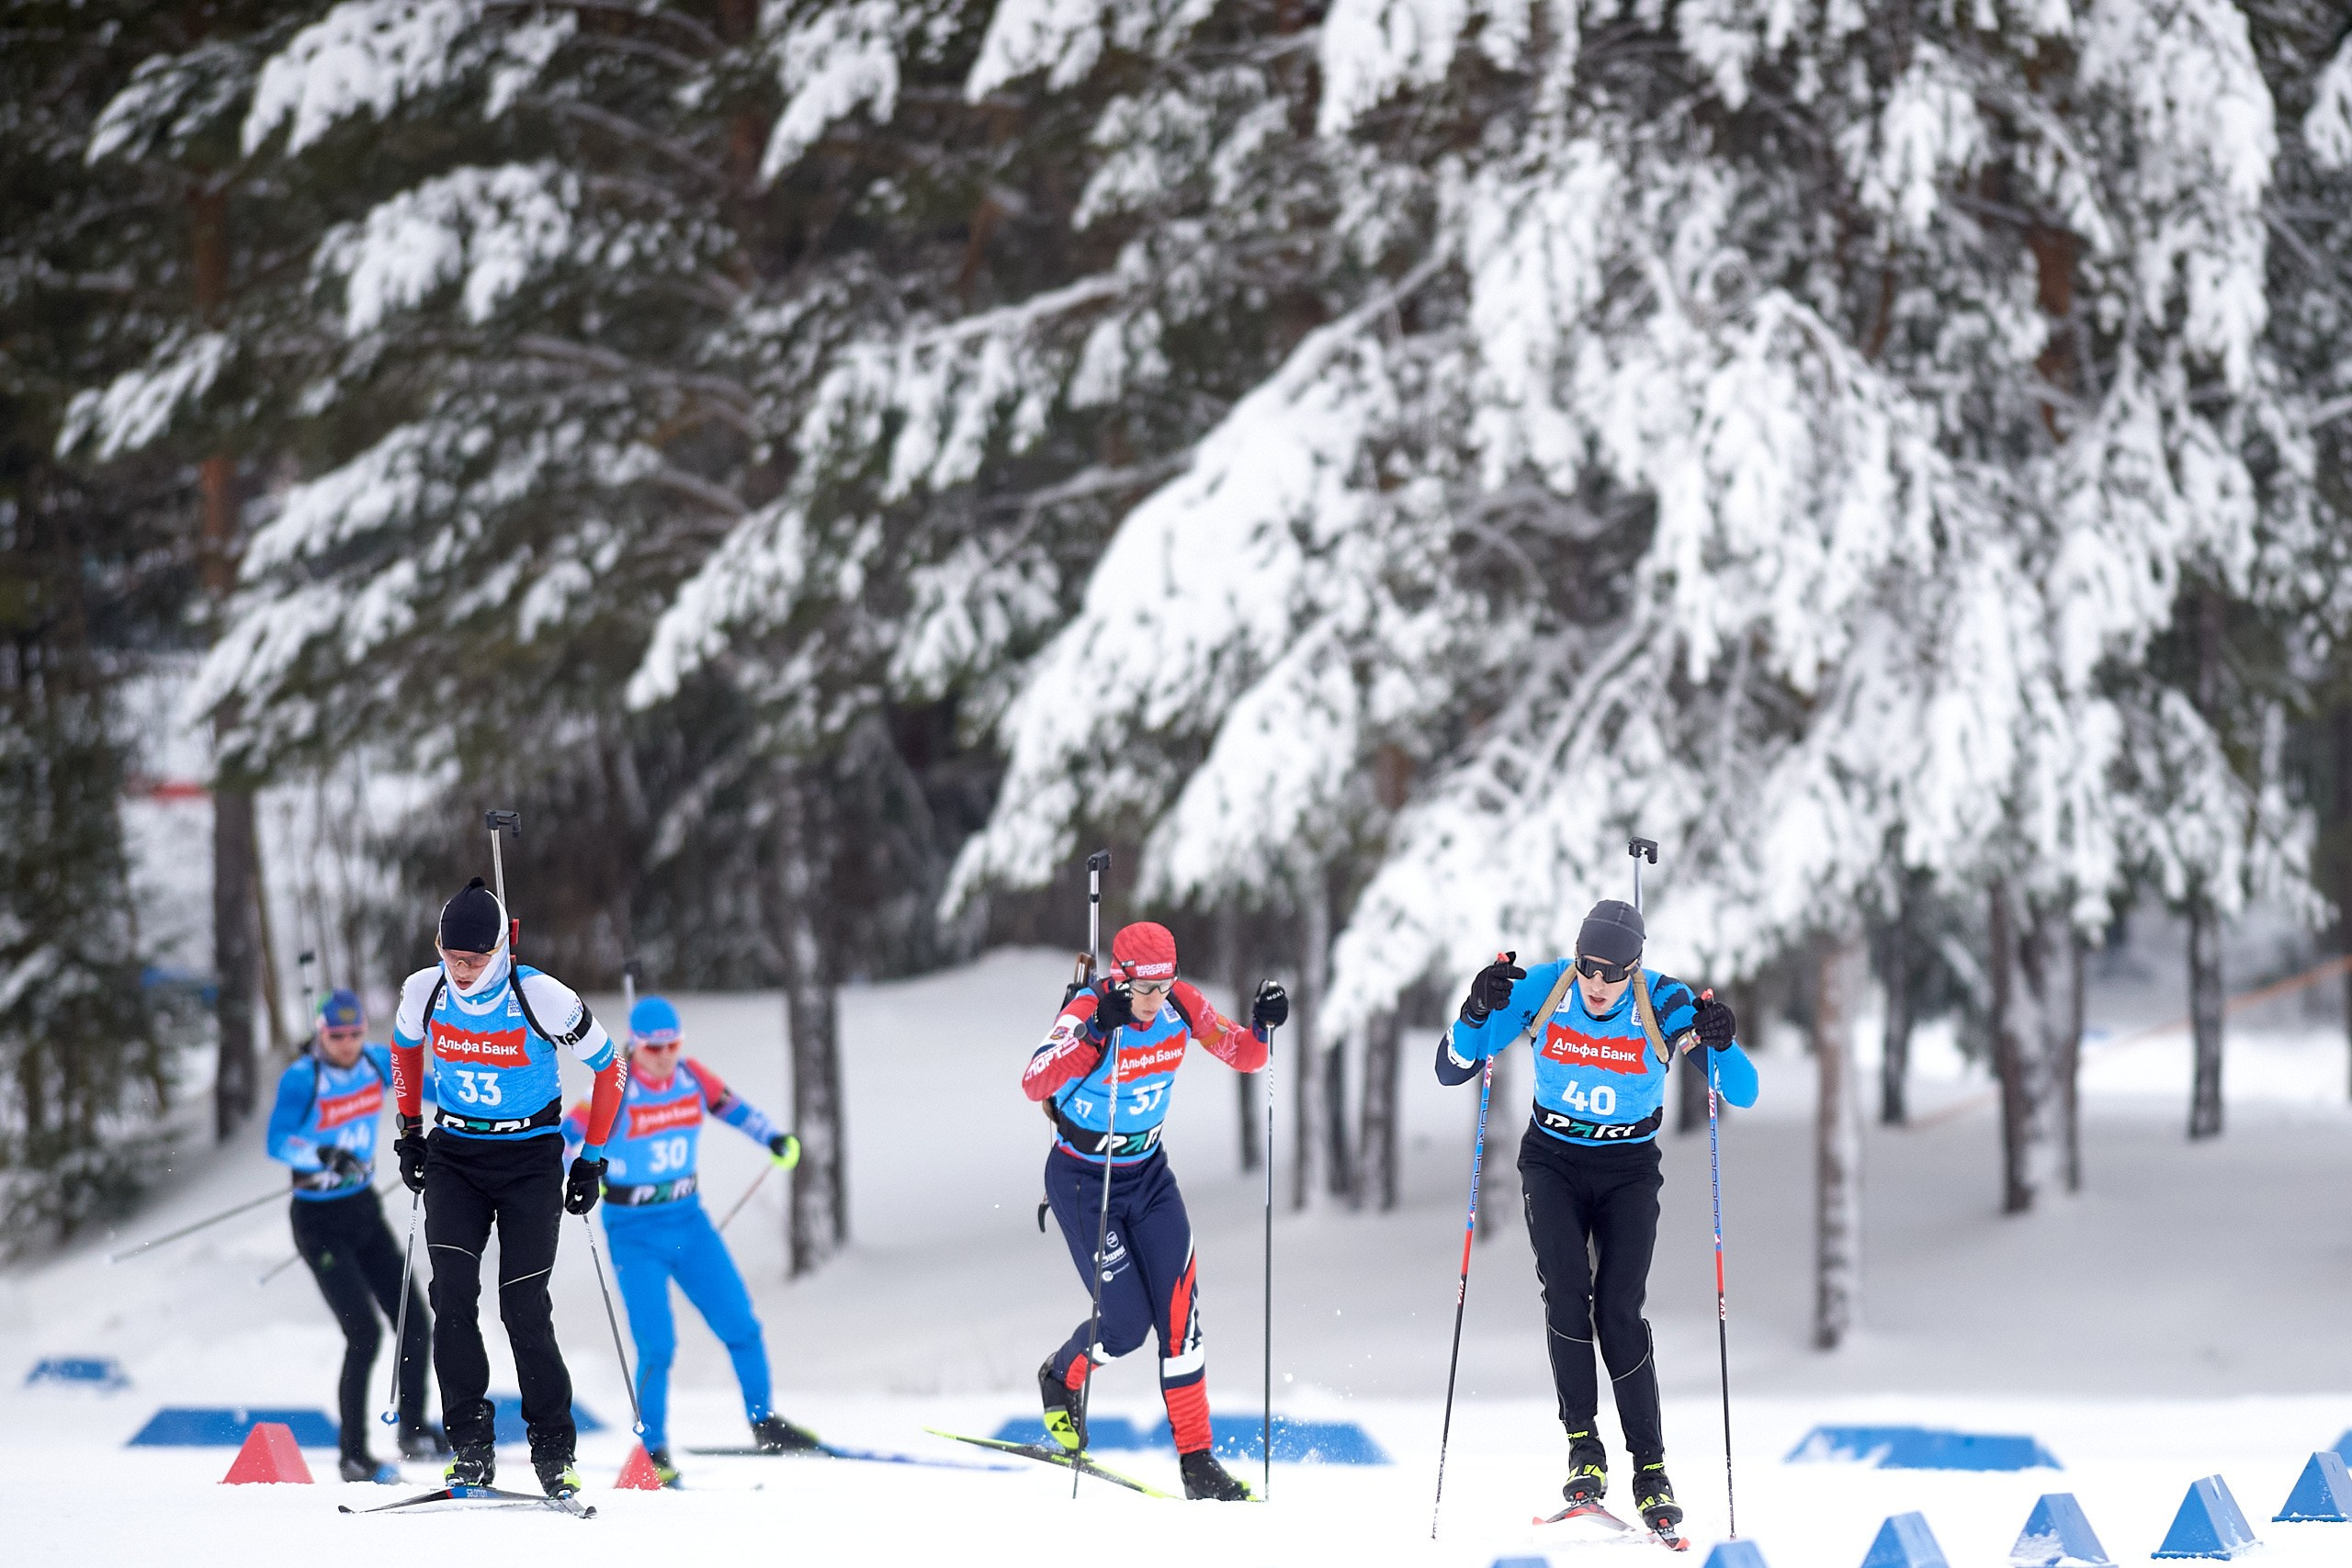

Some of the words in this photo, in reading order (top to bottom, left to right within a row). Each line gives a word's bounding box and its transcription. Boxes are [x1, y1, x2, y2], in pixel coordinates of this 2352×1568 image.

[437, 1034, 480, 1055] Альфа
[482, 1041, 518, 1055] Банк
[1551, 1037, 1599, 1057] Альфа
[1600, 1045, 1636, 1063] Банк
[1119, 1054, 1156, 1076] Альфа
[1156, 1047, 1183, 1062] Банк
[456, 1069, 502, 1106] 33
[1129, 1080, 1167, 1115] 37
[1562, 1079, 1616, 1116] 40
[1095, 1124, 1162, 1154] PAR
[649, 1136, 688, 1173] 30
[1567, 1430, 1589, 1438] CHER
[1643, 1462, 1664, 1471] FISC
